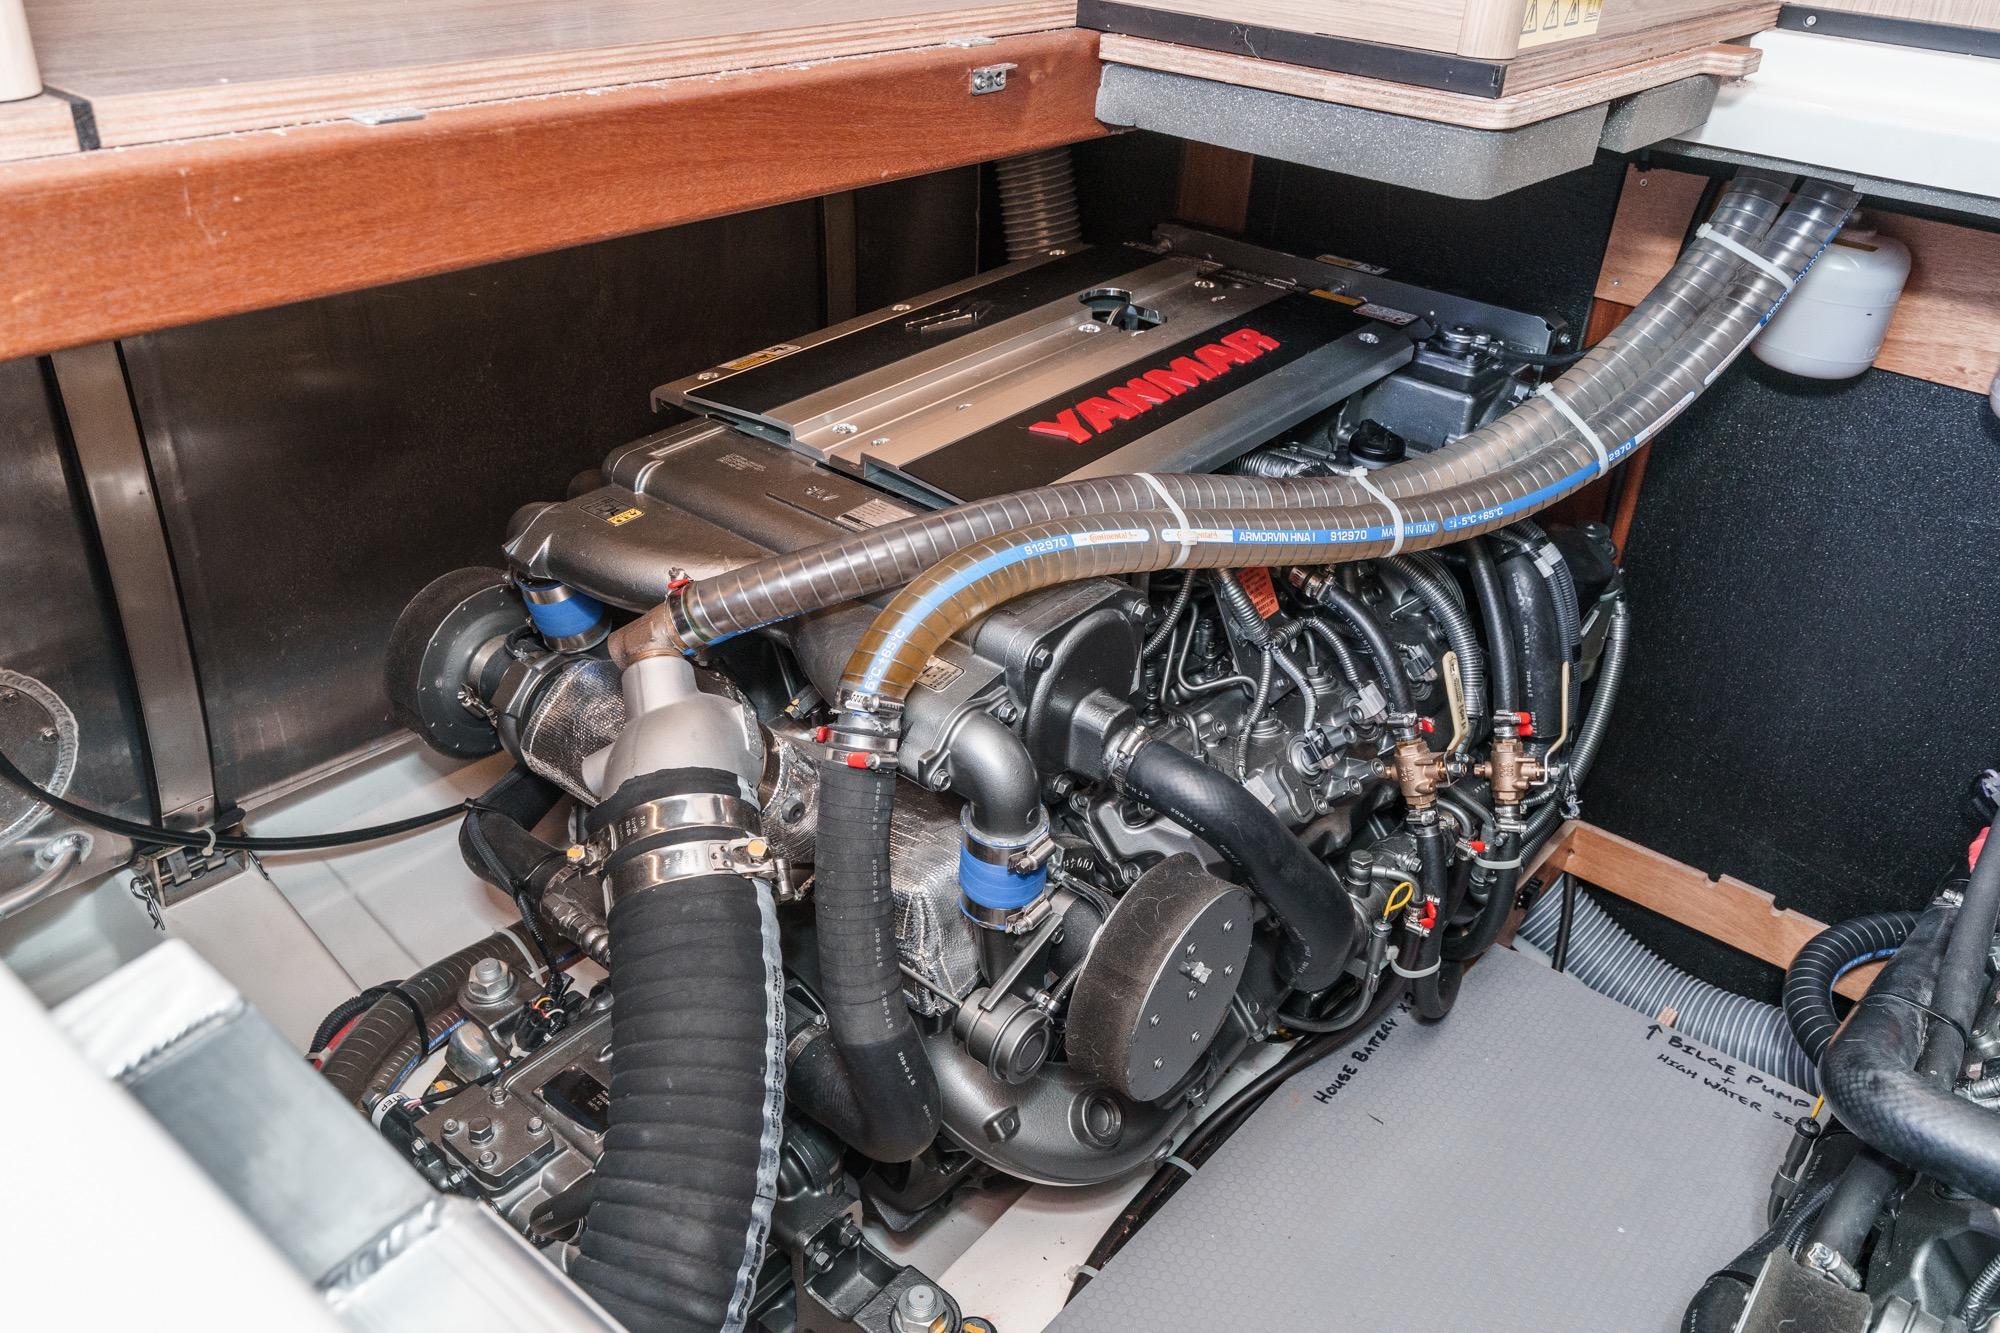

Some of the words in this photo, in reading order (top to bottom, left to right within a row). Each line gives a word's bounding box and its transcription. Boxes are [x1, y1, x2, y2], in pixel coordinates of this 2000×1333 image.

[1028, 327, 1281, 444] YANMAR
[1609, 442, 1632, 463] 2970
[1239, 531, 1290, 542] ARMORVIN
[1290, 531, 1310, 542] HNA
[1330, 529, 1368, 542] 912970
[1404, 525, 1414, 536] IN
[1415, 522, 1436, 535] ITALY
[1477, 507, 1504, 525] +65°C
[1024, 538, 1068, 556] 912970
[1089, 532, 1130, 544] Continental
[1313, 1064, 1358, 1105] HOUSE
[1351, 1018, 1400, 1063] BATTERY
[1667, 1035, 1737, 1077] BILGE
[1746, 1074, 1811, 1109] PUMP
[1657, 1053, 1698, 1080] HIGH
[1703, 1077, 1763, 1113] WATER
[1771, 1110, 1796, 1127] SE
